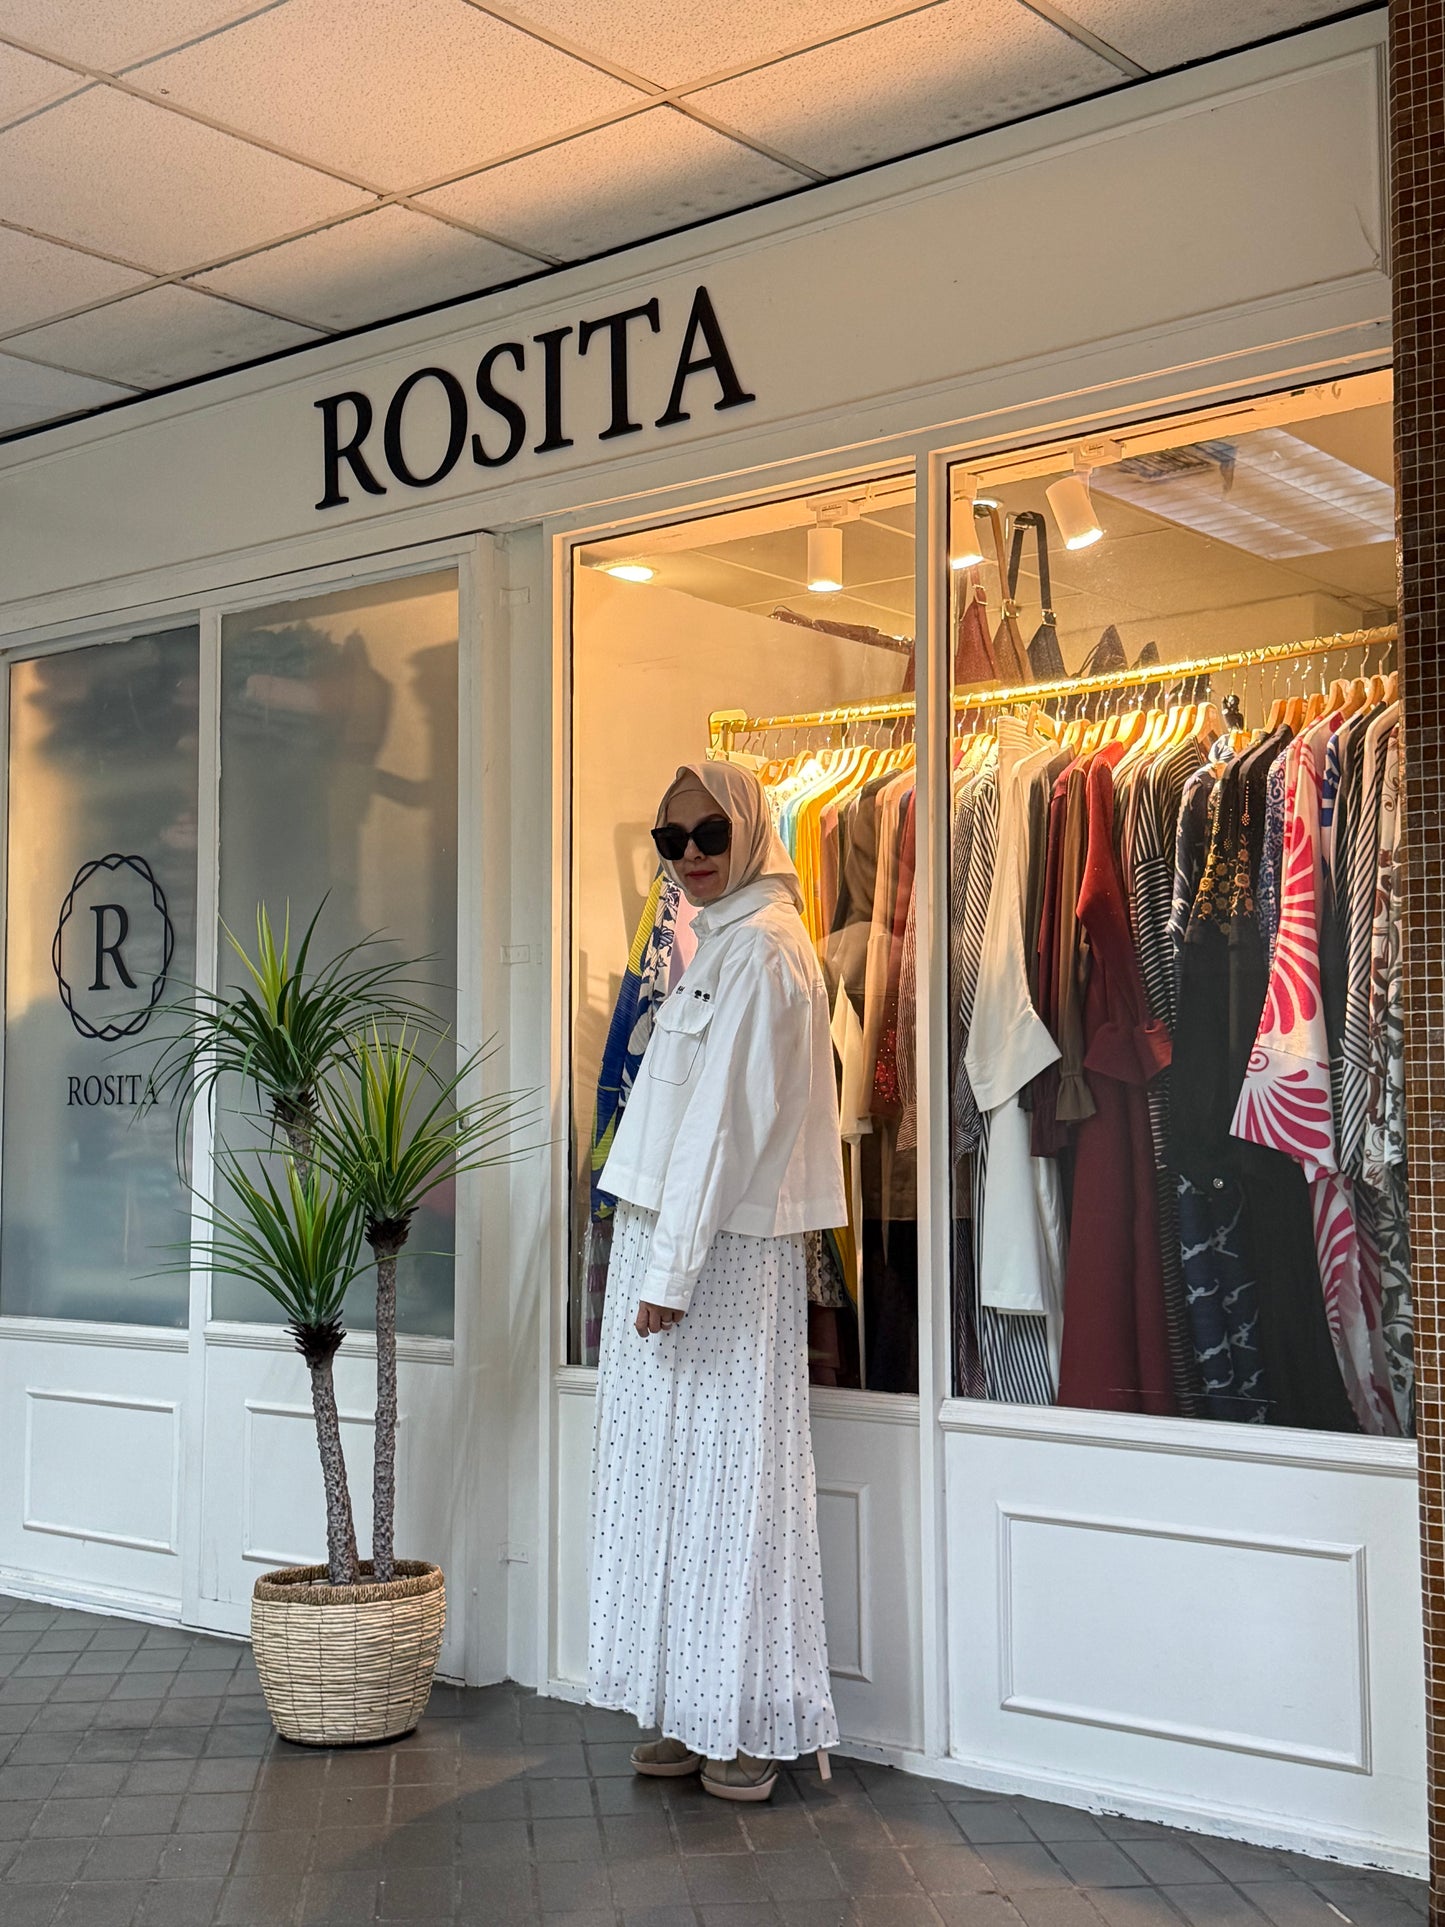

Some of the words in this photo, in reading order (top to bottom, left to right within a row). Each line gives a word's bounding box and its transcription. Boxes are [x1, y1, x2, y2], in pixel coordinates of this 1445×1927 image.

[313, 285, 756, 510] ROSITA
[88, 904, 137, 991] R
[67, 1074, 159, 1106] ROSITA
